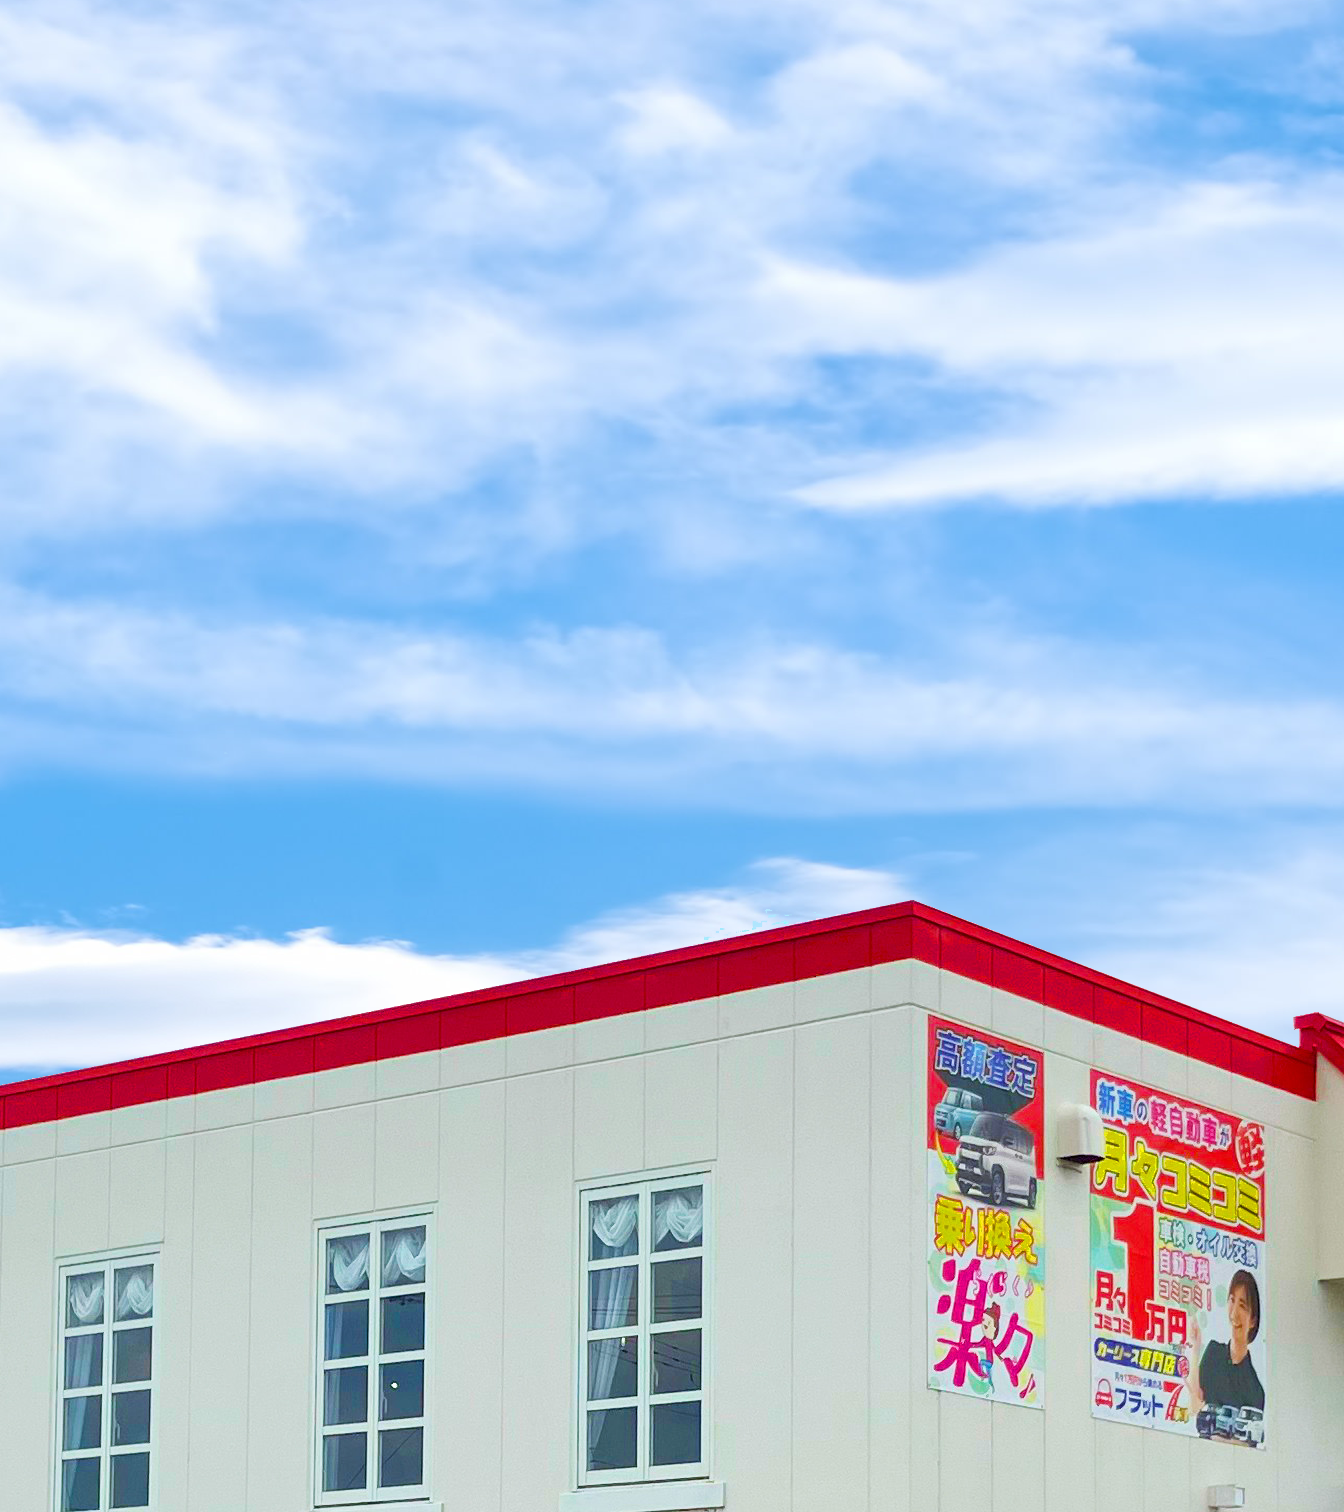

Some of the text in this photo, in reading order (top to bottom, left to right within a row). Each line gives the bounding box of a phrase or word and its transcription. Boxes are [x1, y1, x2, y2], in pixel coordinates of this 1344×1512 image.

[935, 1030, 1037, 1099] 高額査定
[1097, 1080, 1231, 1150] 新車の軽自動車が
[1095, 1127, 1263, 1231] 月々コミコミ
[934, 1194, 1038, 1264] 乗り換え
[934, 1259, 1034, 1388] 楽々
[1094, 1312, 1132, 1336] コミコミ
[1095, 1271, 1126, 1314] 月々
[1145, 1302, 1188, 1345] 万円
